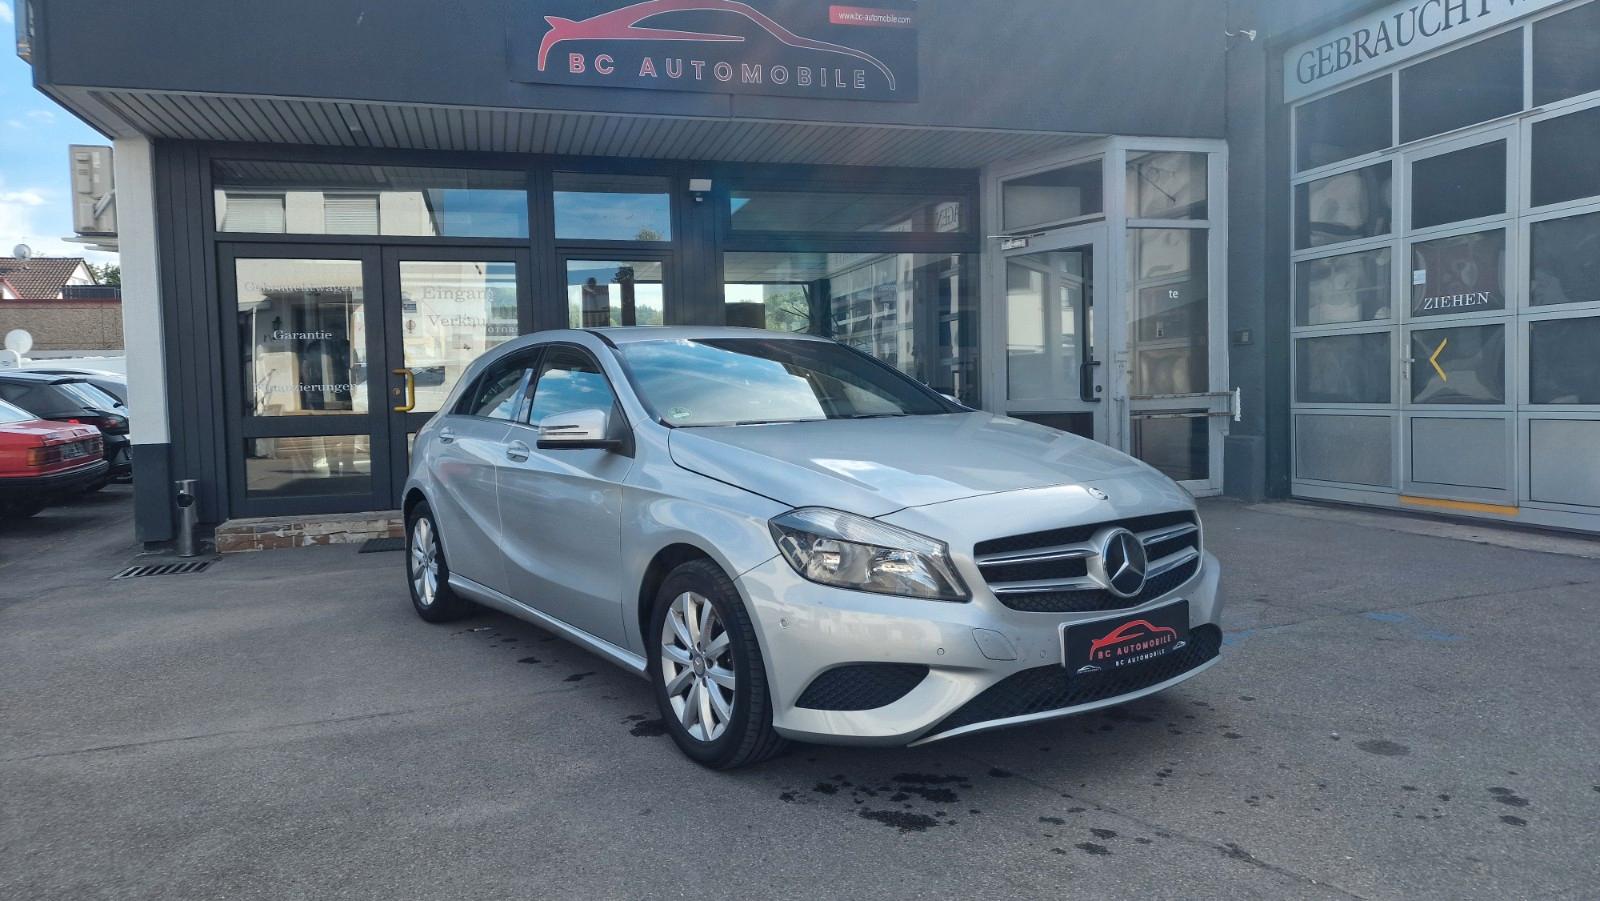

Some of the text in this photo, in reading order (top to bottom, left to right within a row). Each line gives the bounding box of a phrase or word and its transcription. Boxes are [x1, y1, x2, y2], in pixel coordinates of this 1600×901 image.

[569, 53, 866, 89] BC AUTOMOBILE
[1423, 291, 1491, 310] ZIEHEN
[273, 329, 333, 341] Garantie
[1097, 634, 1171, 660] BC AUTOMOBILE
[1115, 648, 1165, 667] BC AUTOMOBILE
